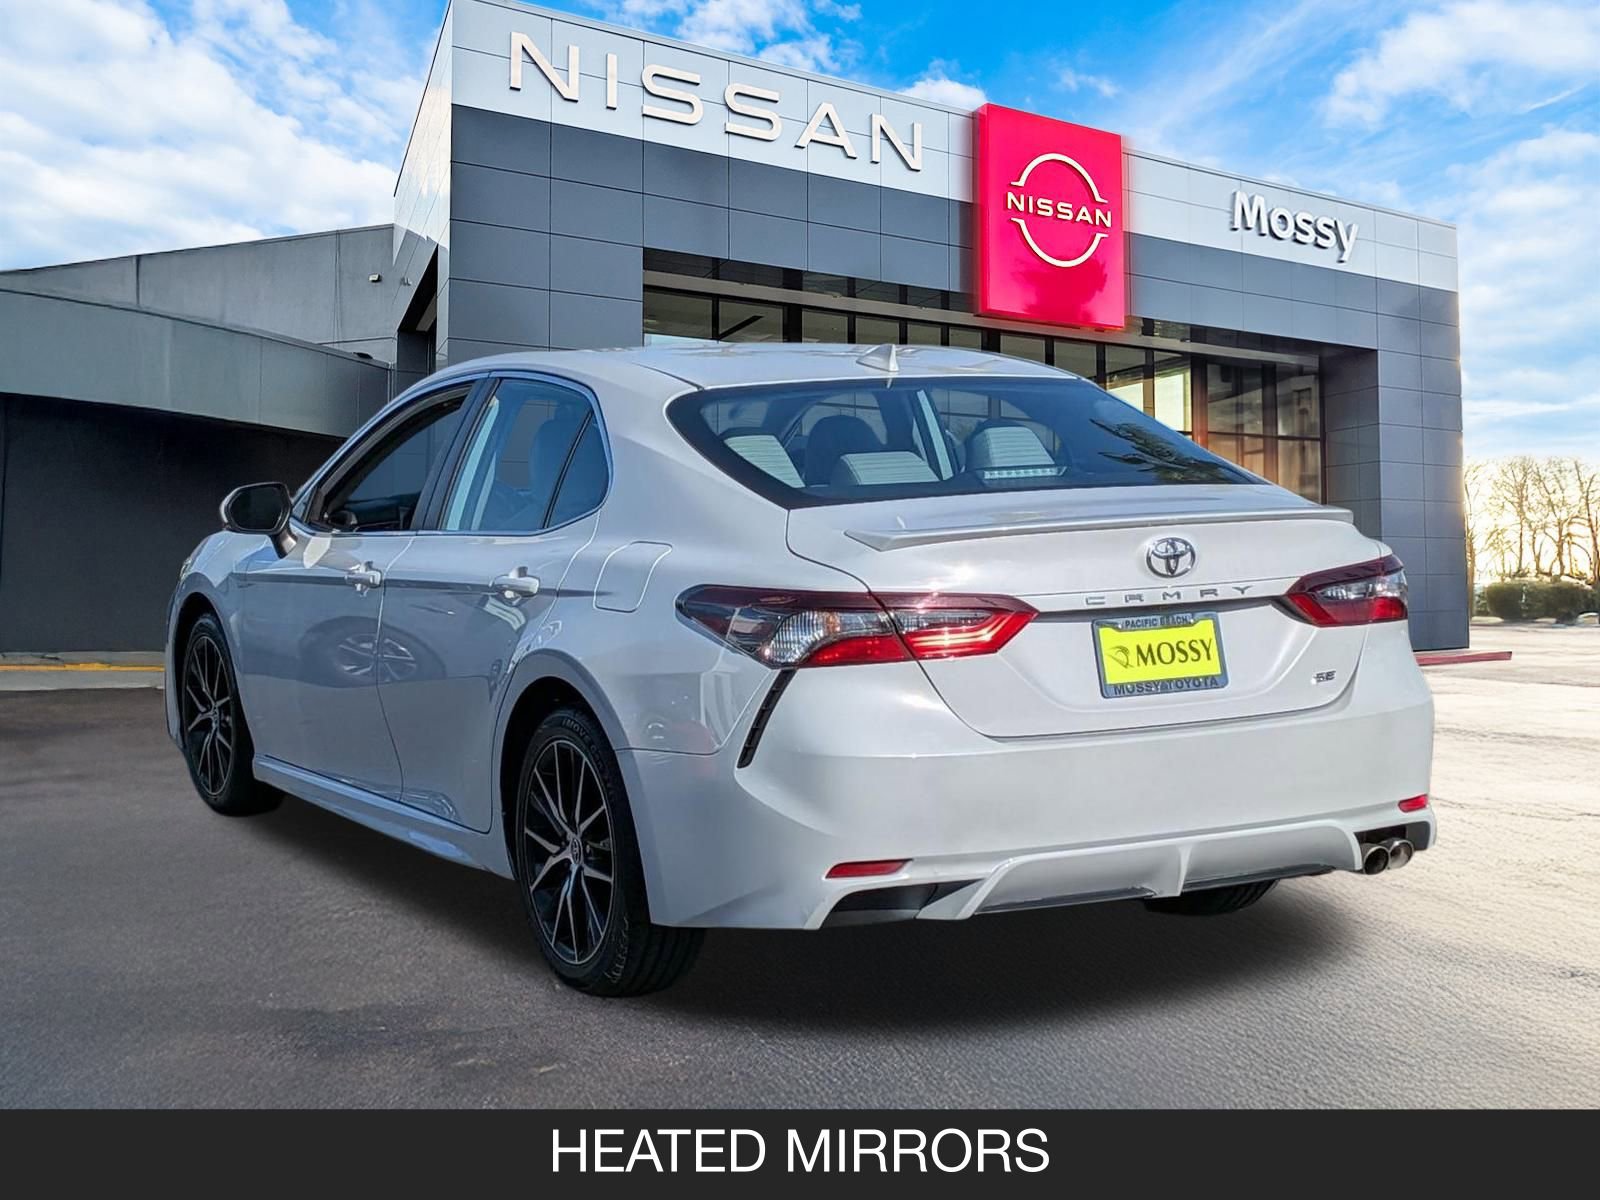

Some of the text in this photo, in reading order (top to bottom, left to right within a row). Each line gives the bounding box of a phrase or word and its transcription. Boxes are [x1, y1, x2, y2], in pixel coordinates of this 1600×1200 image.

[509, 31, 923, 172] NISSAN
[1006, 191, 1112, 228] NISSAN
[1230, 189, 1360, 263] Mossy
[1085, 585, 1253, 606] CAMRY
[1124, 617, 1158, 629] PACIFIC
[1136, 638, 1213, 667] MOSSY
[1113, 677, 1219, 696] MOSSY TOYOTA
[1315, 670, 1337, 683] SE
